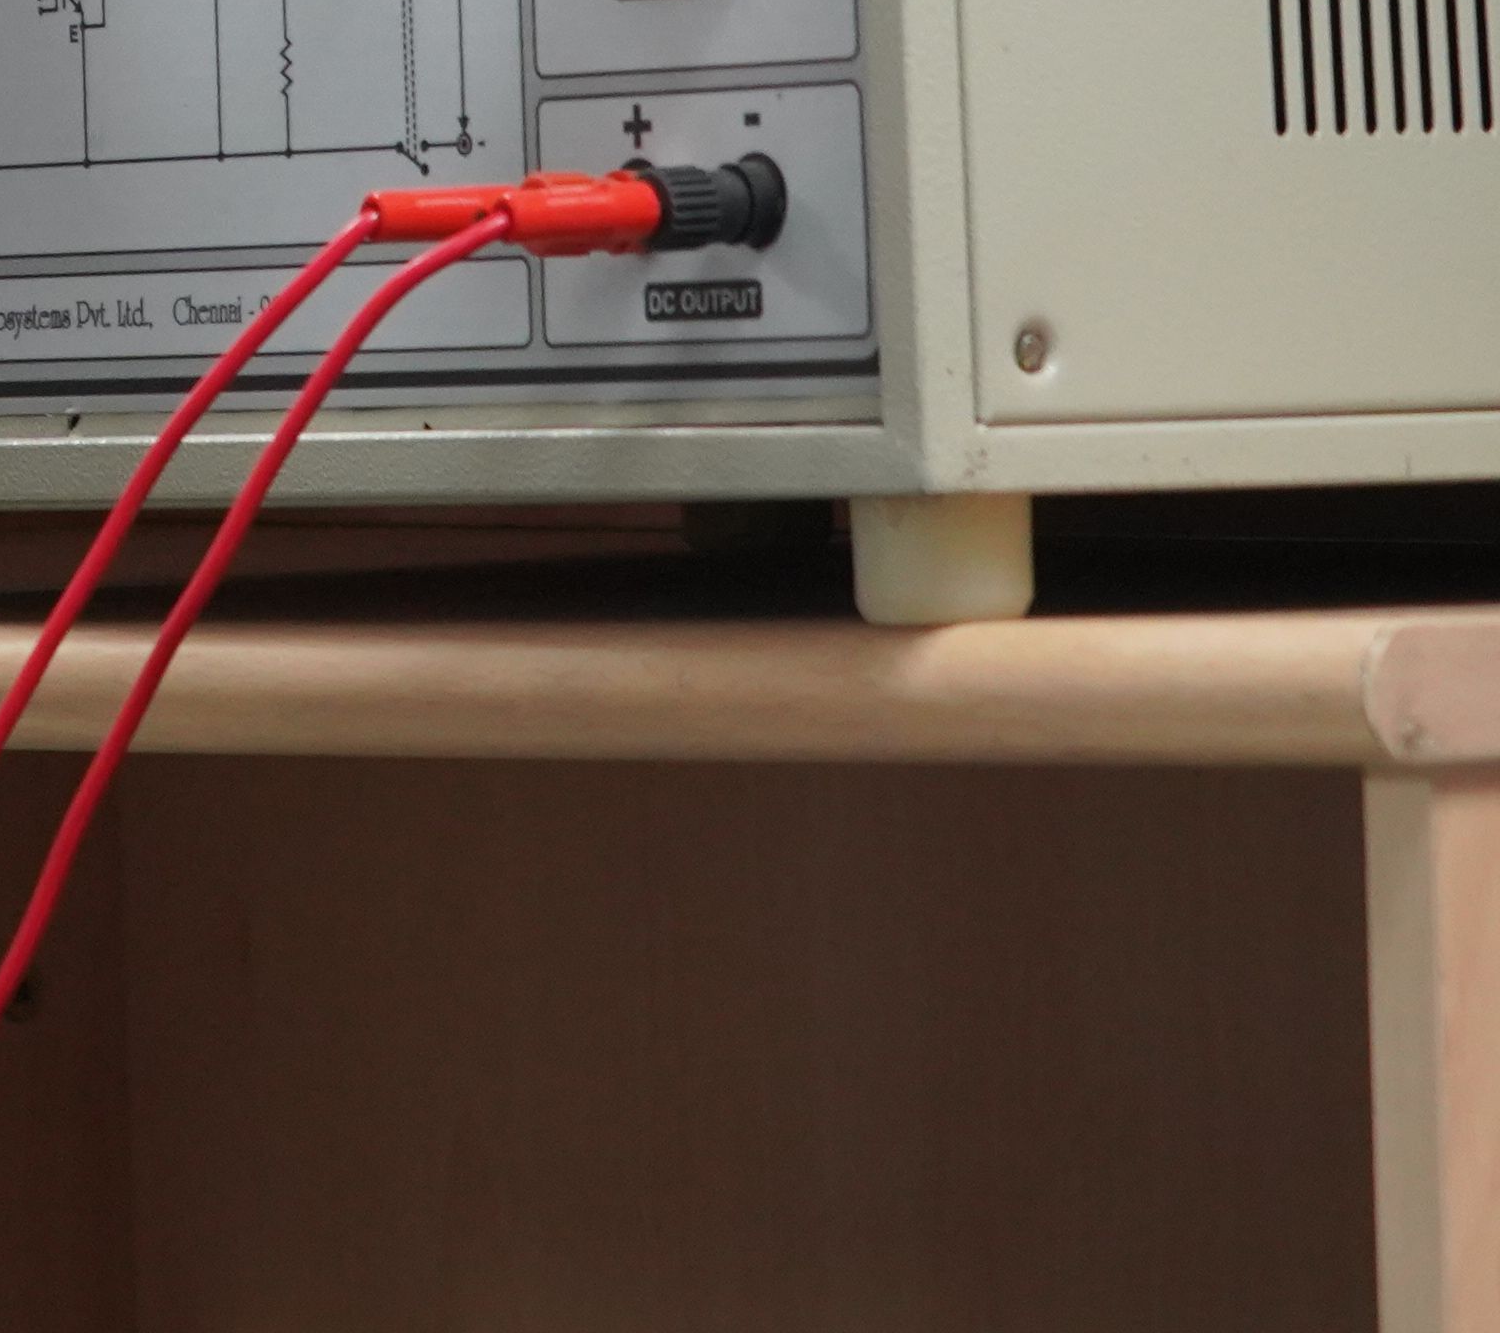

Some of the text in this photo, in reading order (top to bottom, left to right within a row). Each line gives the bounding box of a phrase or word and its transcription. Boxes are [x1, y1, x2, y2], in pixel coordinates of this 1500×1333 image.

[69, 25, 79, 43] E
[173, 295, 242, 325] Chennai
[650, 288, 758, 314] DC OUTPUT
